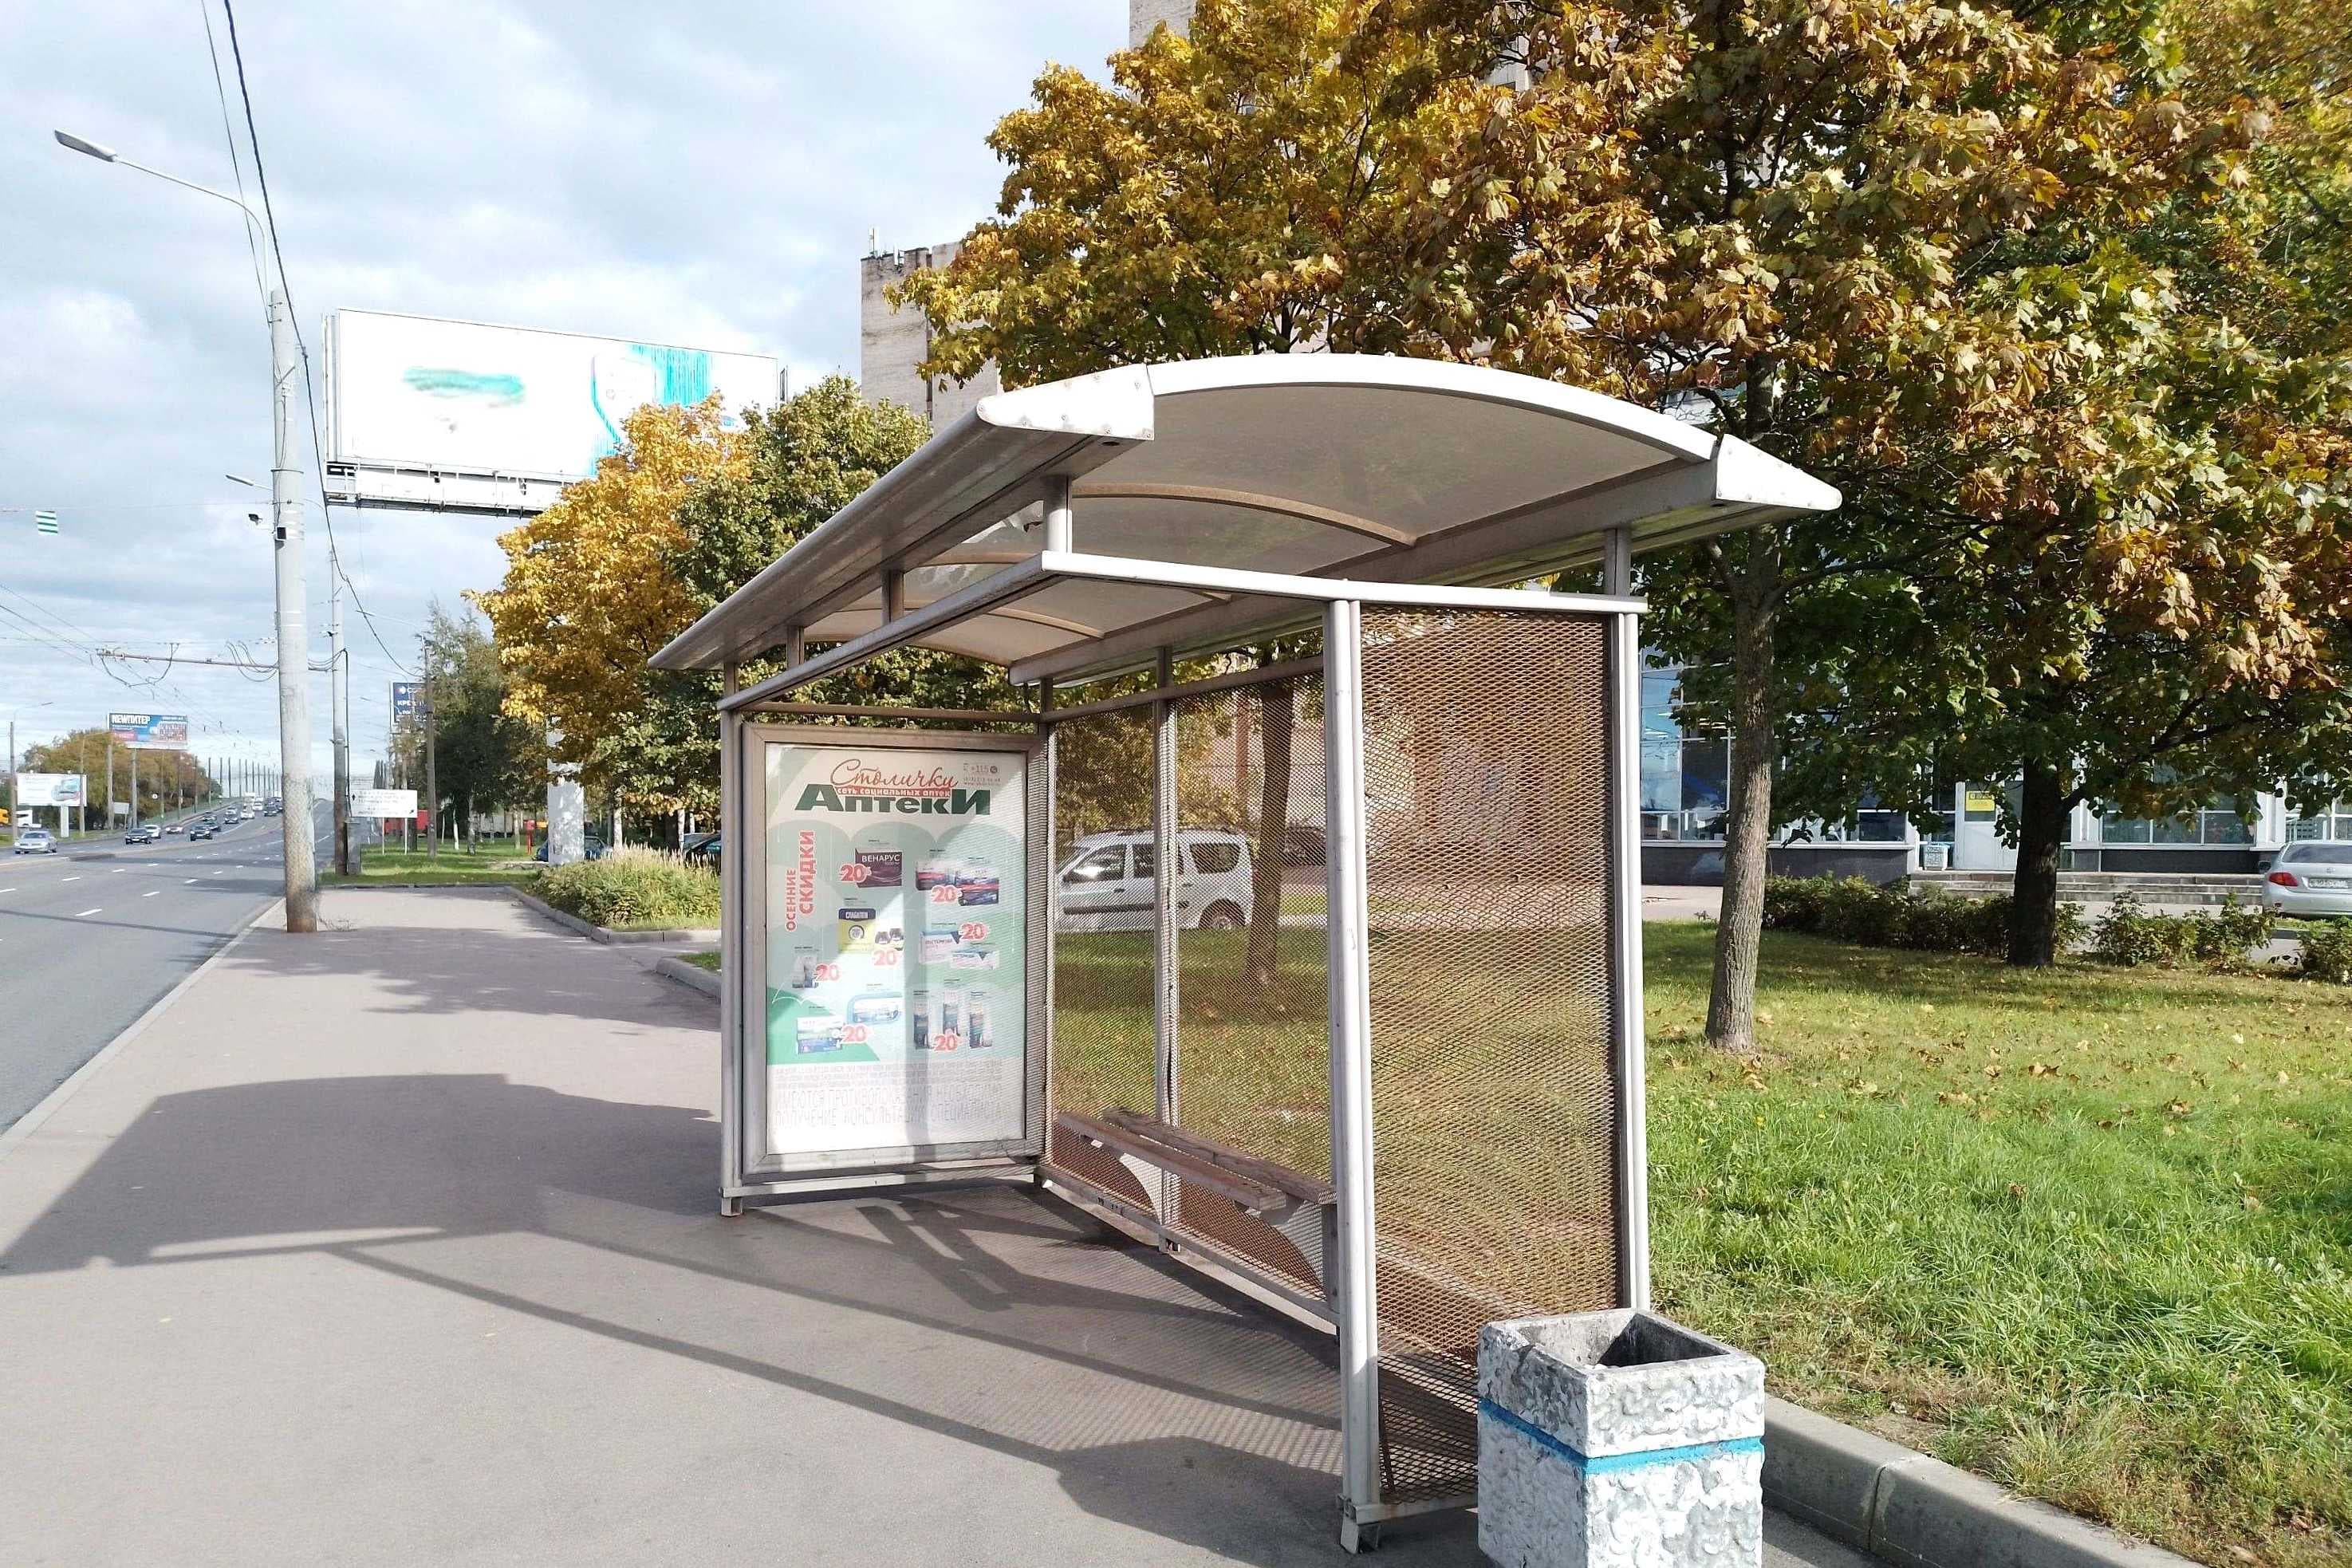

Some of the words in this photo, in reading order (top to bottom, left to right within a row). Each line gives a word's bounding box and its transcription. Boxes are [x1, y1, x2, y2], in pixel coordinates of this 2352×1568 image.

[830, 758, 959, 788] Столички
[861, 788, 920, 797] социальных
[799, 831, 816, 914] СКИДКИ
[786, 869, 796, 931] ОСЕННИЕ
